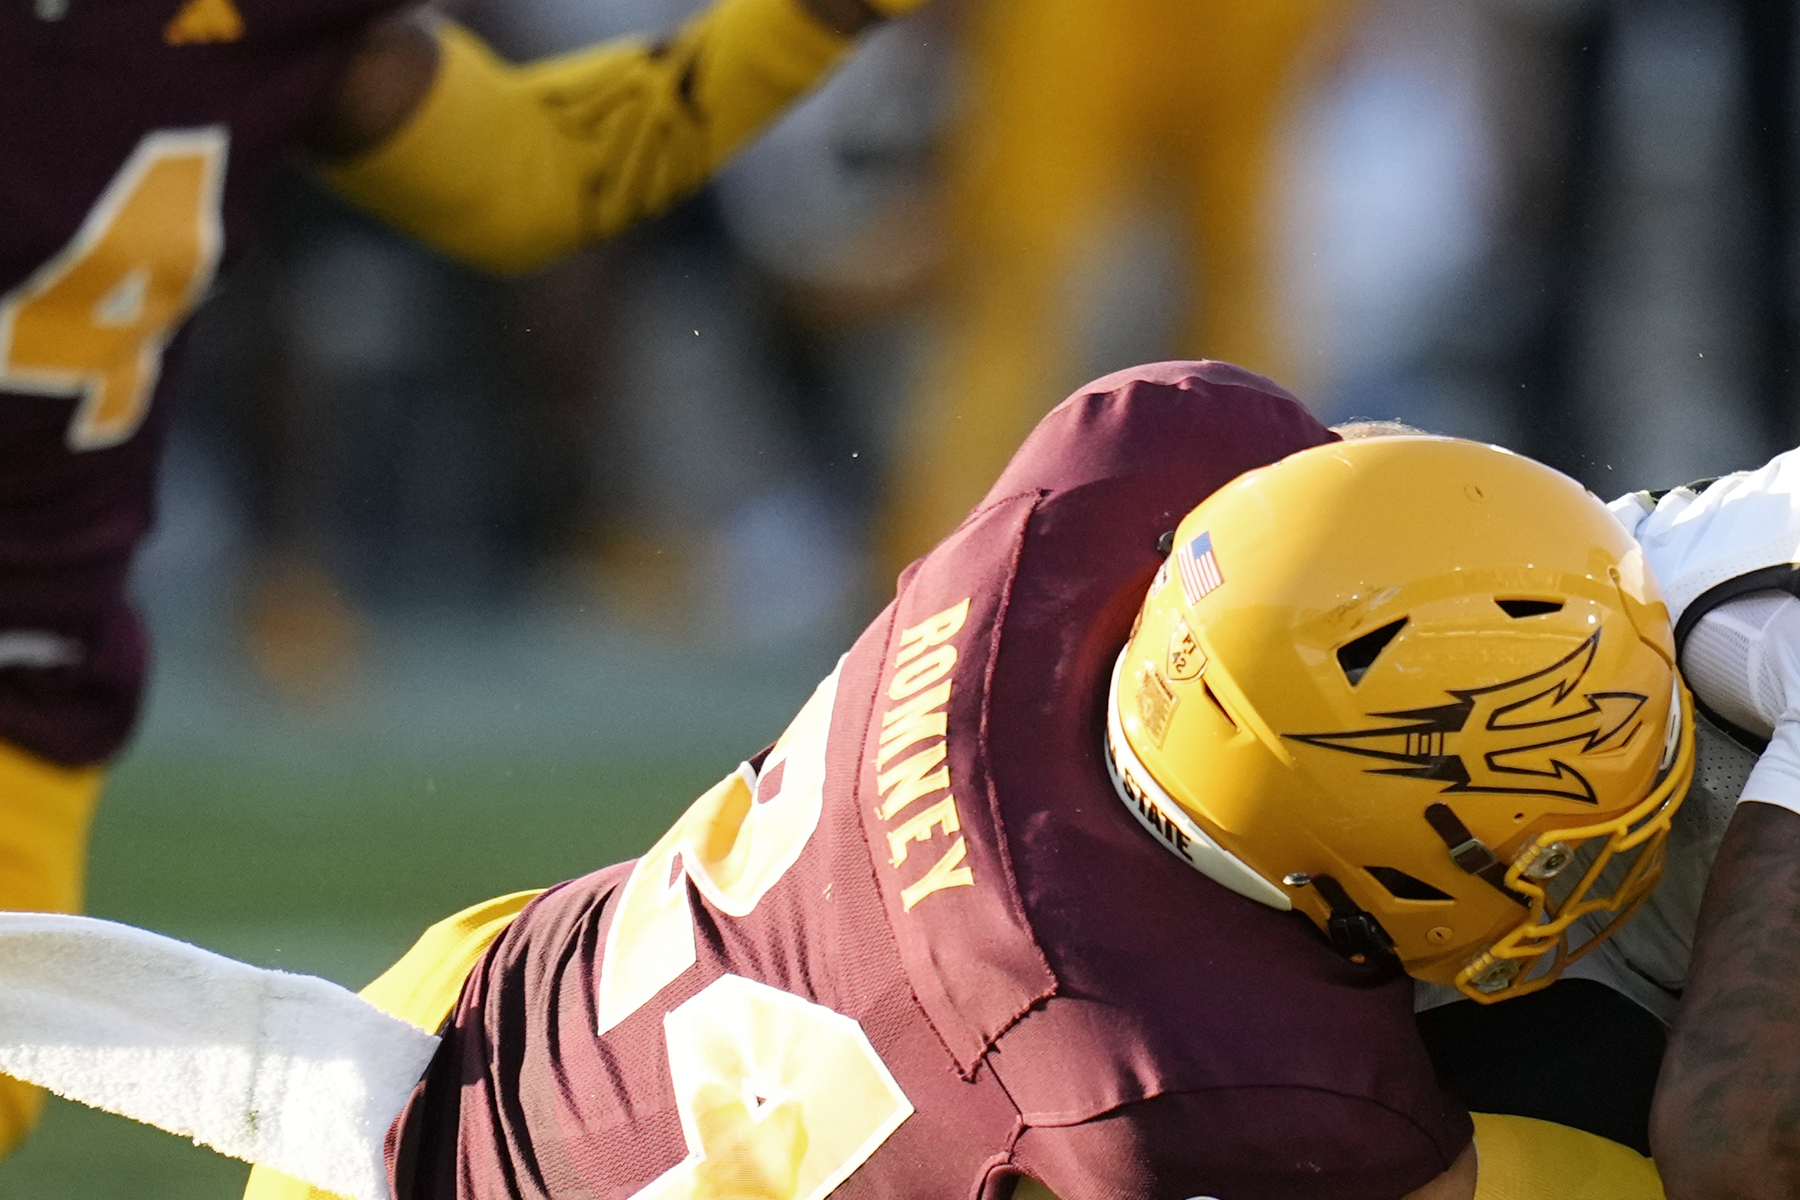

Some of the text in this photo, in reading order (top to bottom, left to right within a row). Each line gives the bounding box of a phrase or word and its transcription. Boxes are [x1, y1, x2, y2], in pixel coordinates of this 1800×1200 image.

[0, 126, 231, 450] 4
[876, 597, 974, 913] ROMNEY
[1172, 651, 1187, 674] 42
[1123, 767, 1194, 862] STATE
